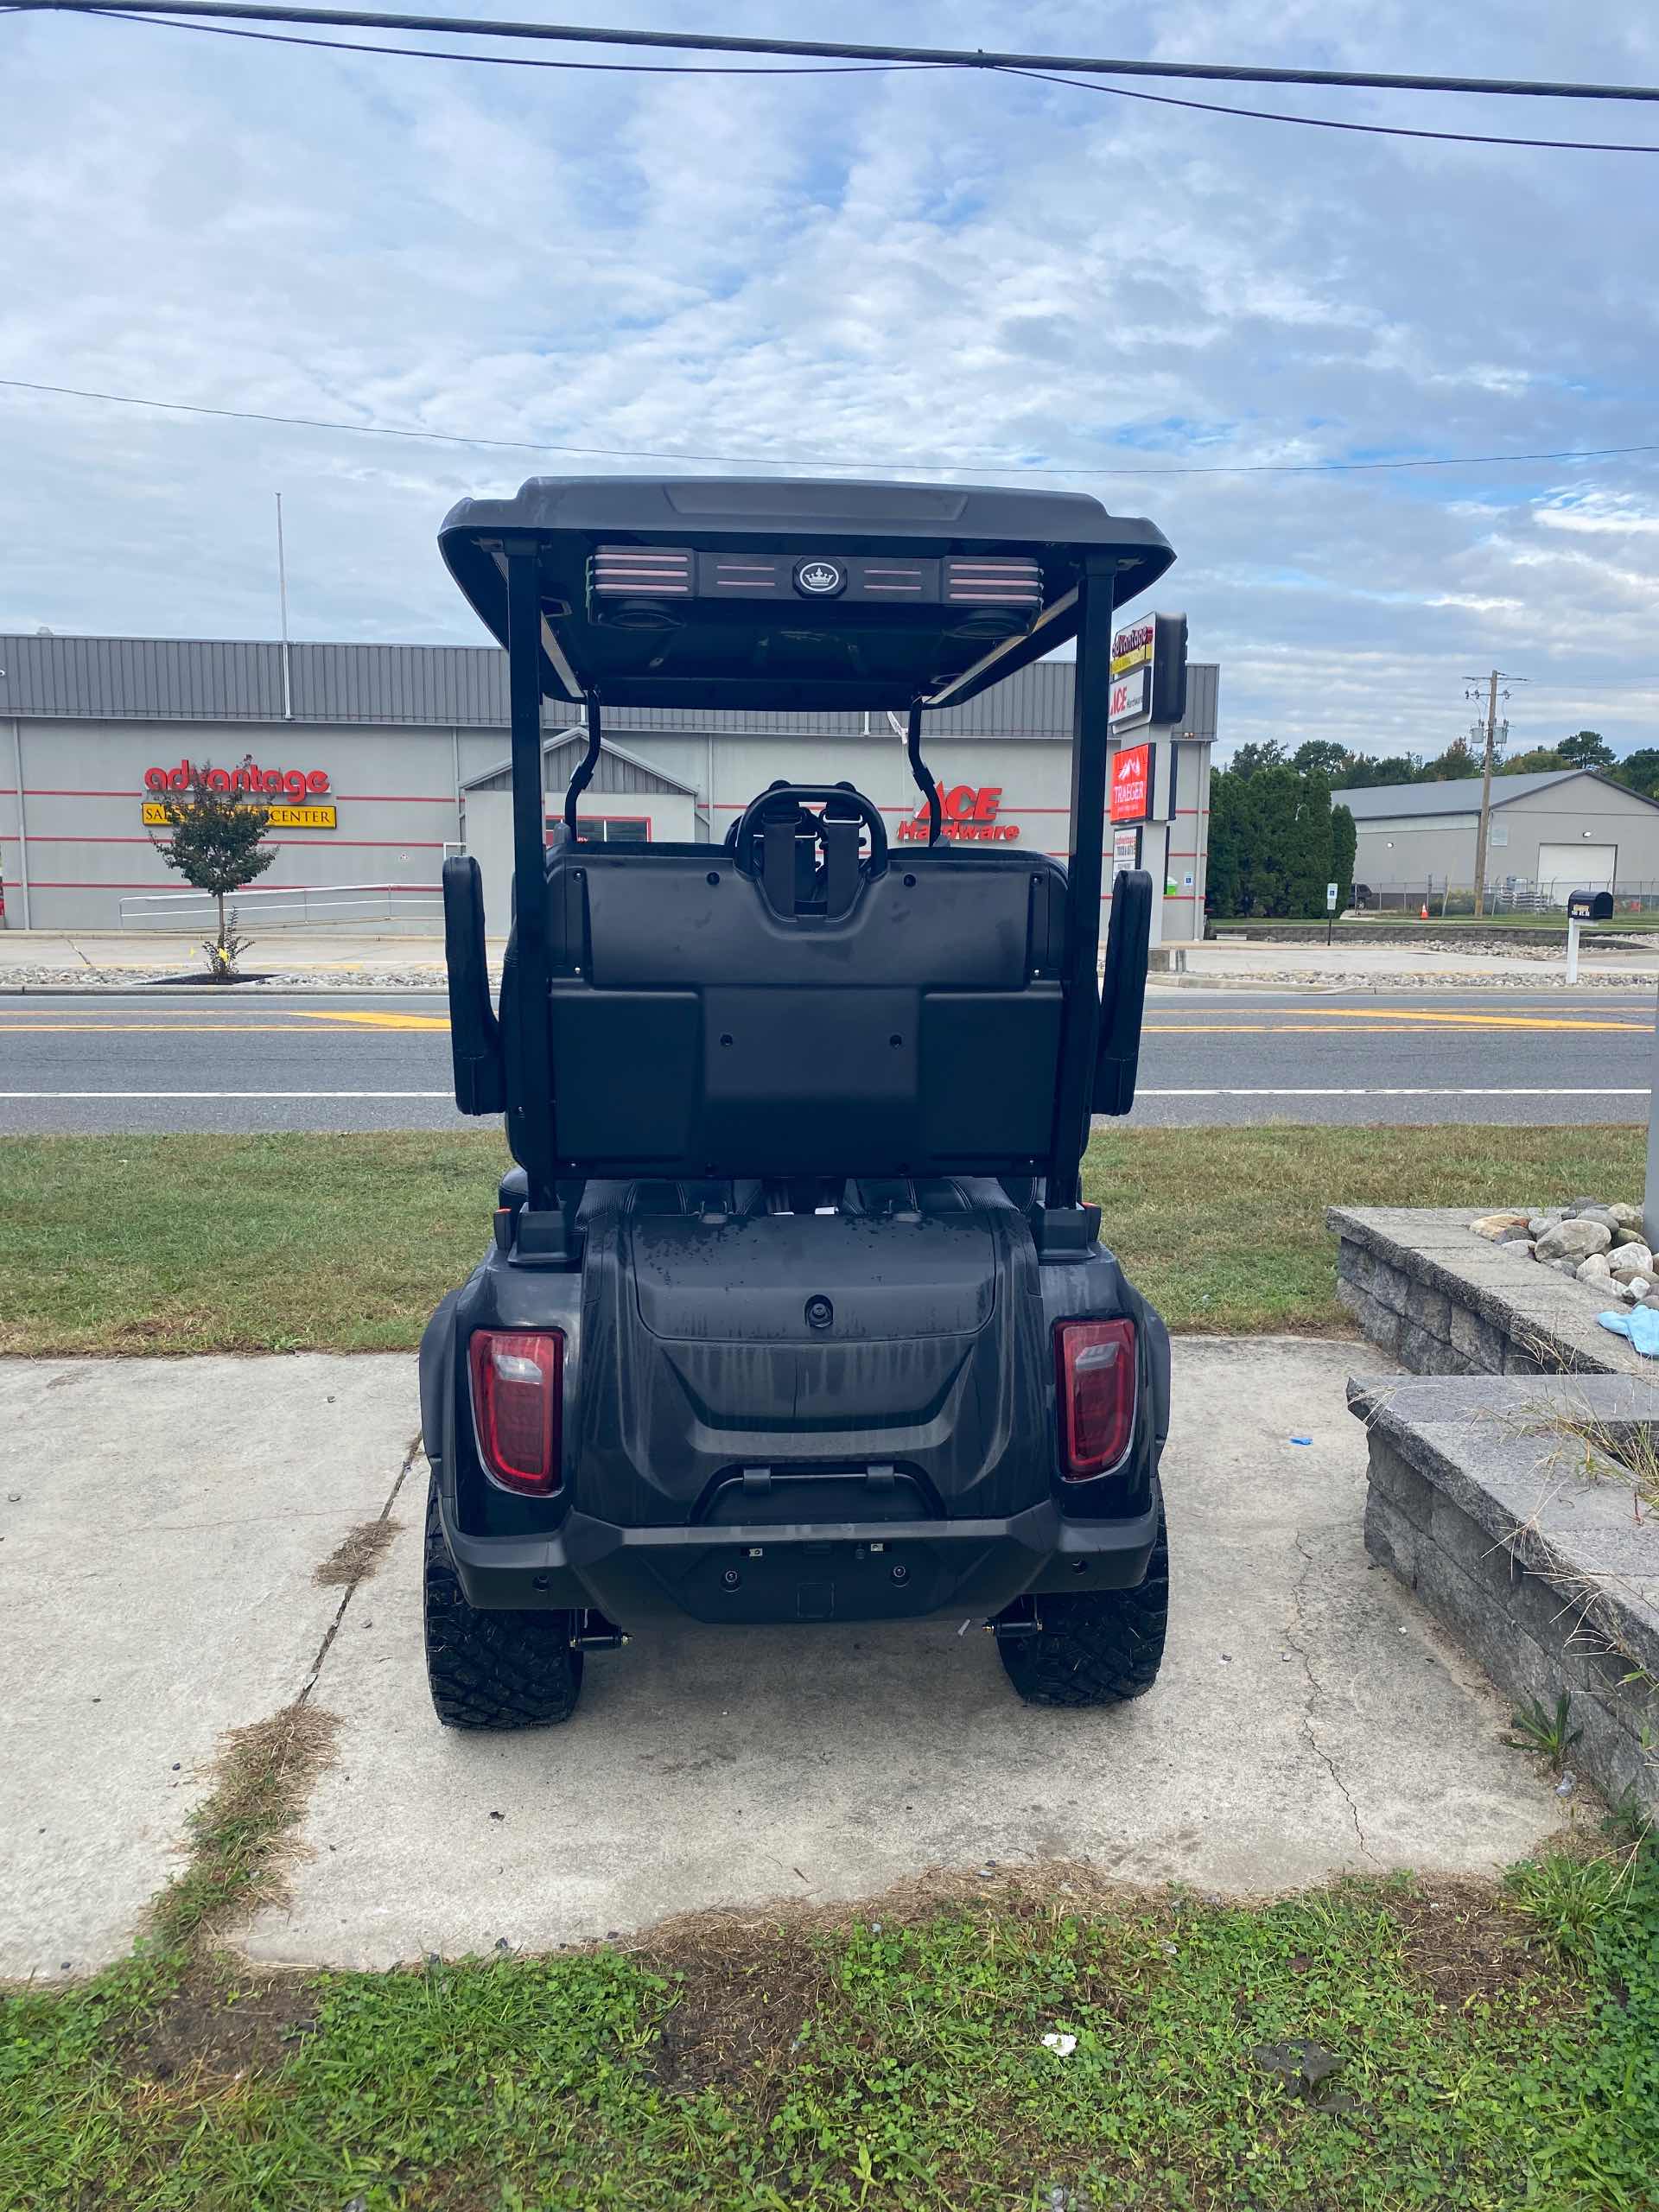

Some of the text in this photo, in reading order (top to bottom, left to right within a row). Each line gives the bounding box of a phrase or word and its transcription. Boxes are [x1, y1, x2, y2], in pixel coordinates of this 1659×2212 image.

[1110, 686, 1127, 715] ACE
[917, 780, 1002, 820] ACE
[1114, 780, 1144, 804] TRAEGER
[270, 810, 331, 823] CENTER
[898, 820, 1020, 841] Hadware
